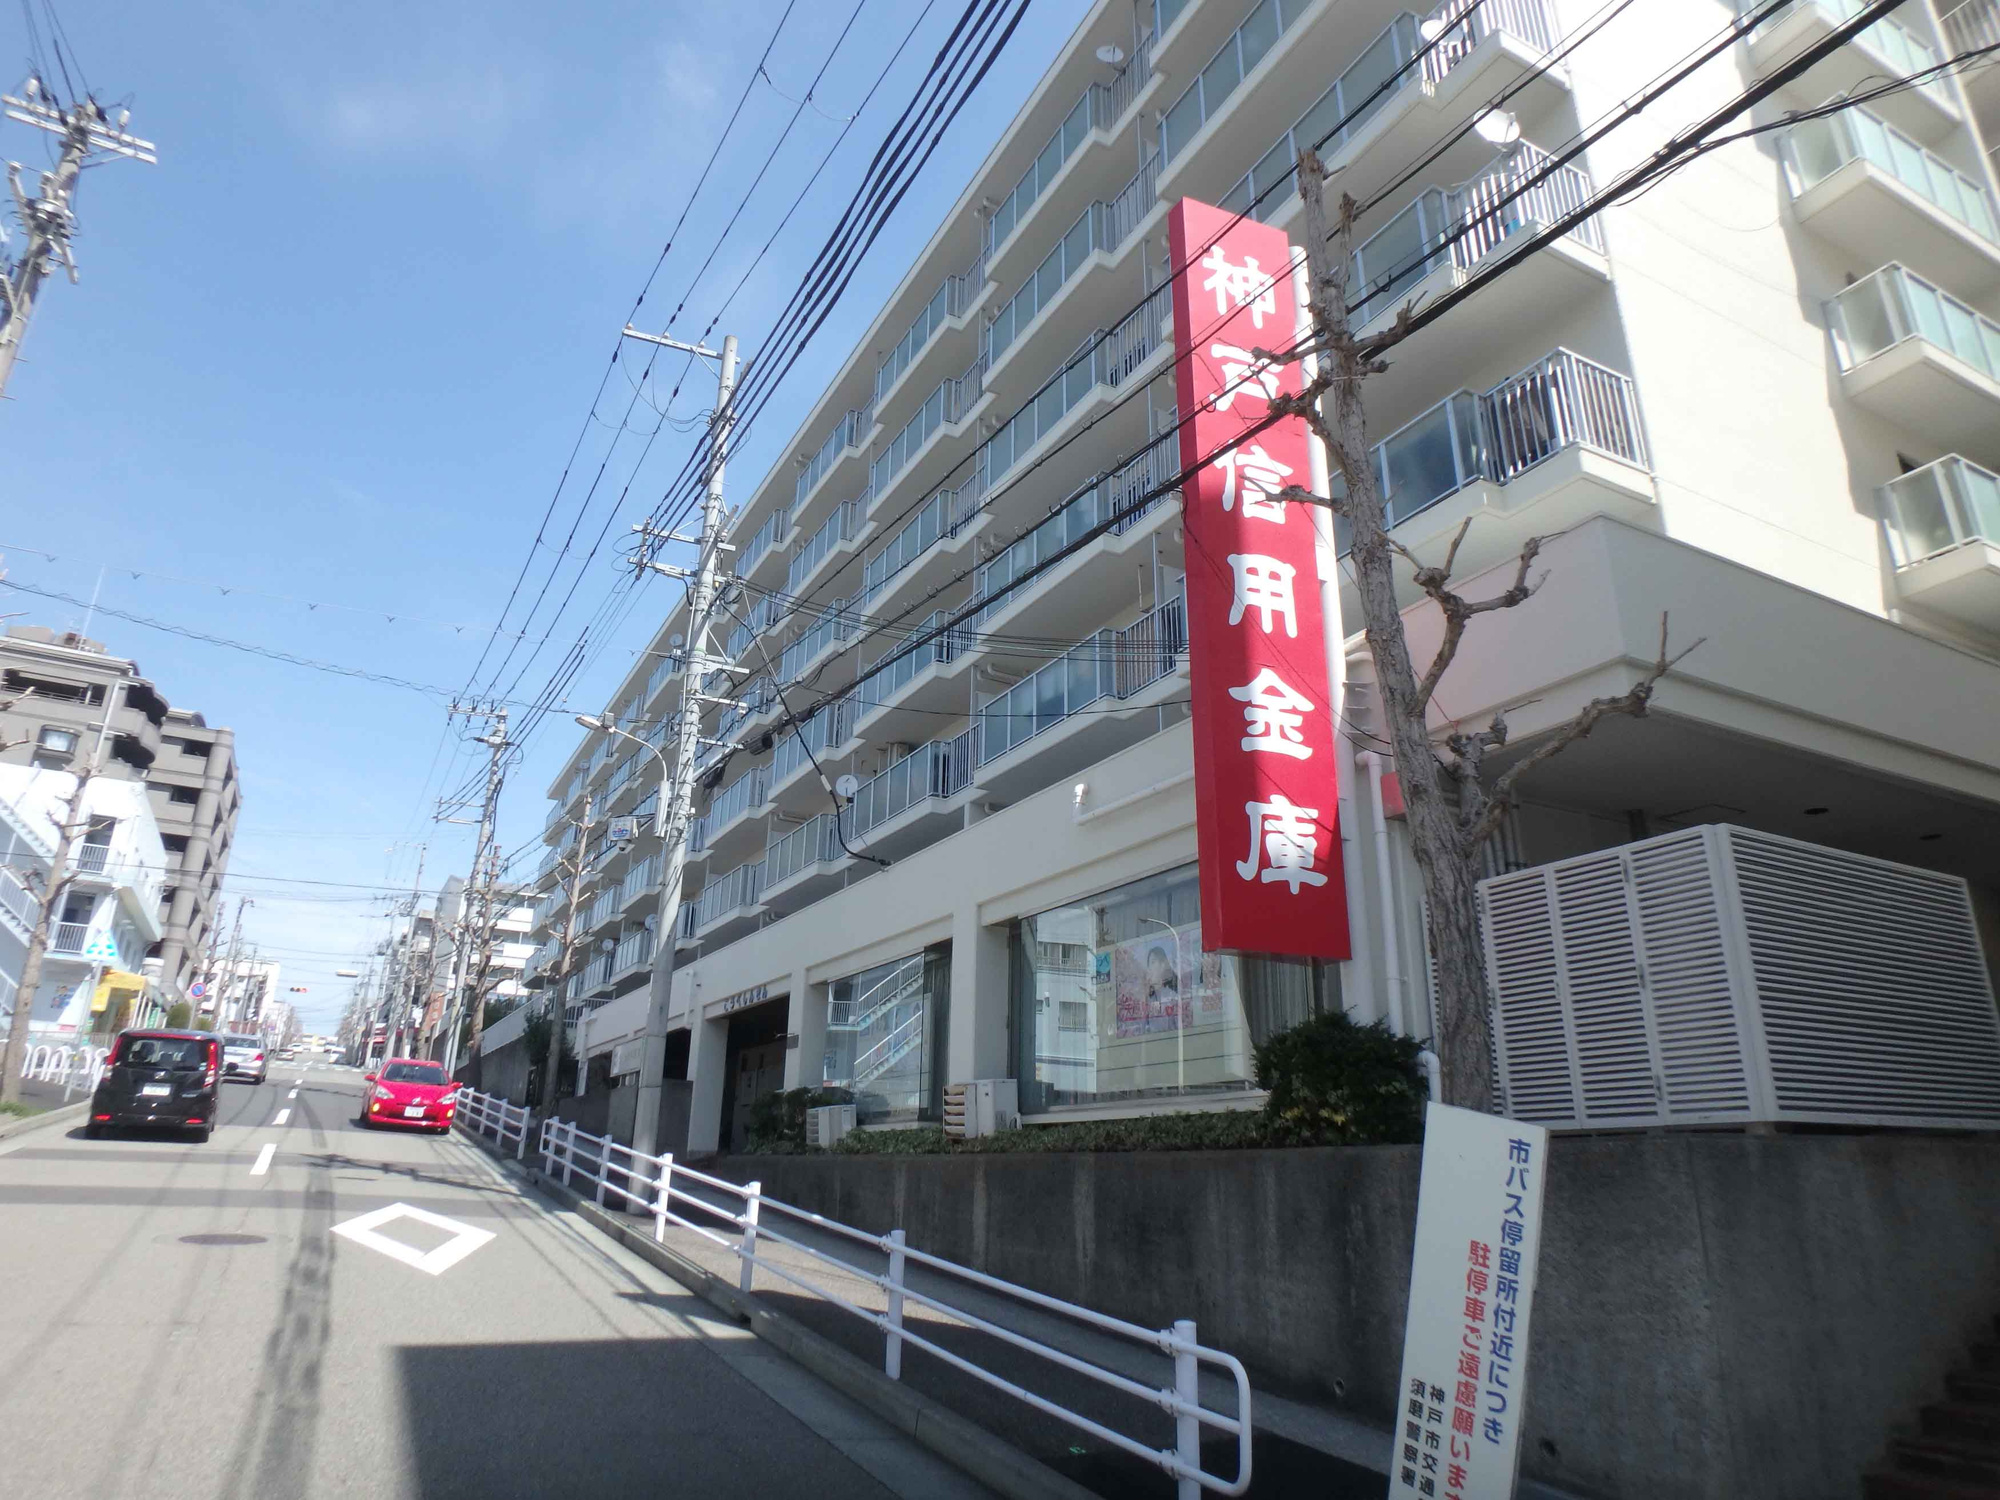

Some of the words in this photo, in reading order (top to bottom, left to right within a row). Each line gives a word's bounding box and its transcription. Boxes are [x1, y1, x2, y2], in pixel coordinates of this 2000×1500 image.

[1202, 245, 1329, 895] 神戸信用金庫
[1483, 1138, 1531, 1445] 市バス停留所付近につき
[1401, 1378, 1426, 1488] 須磨警察署
[1418, 1384, 1445, 1500] 神戸市交通
